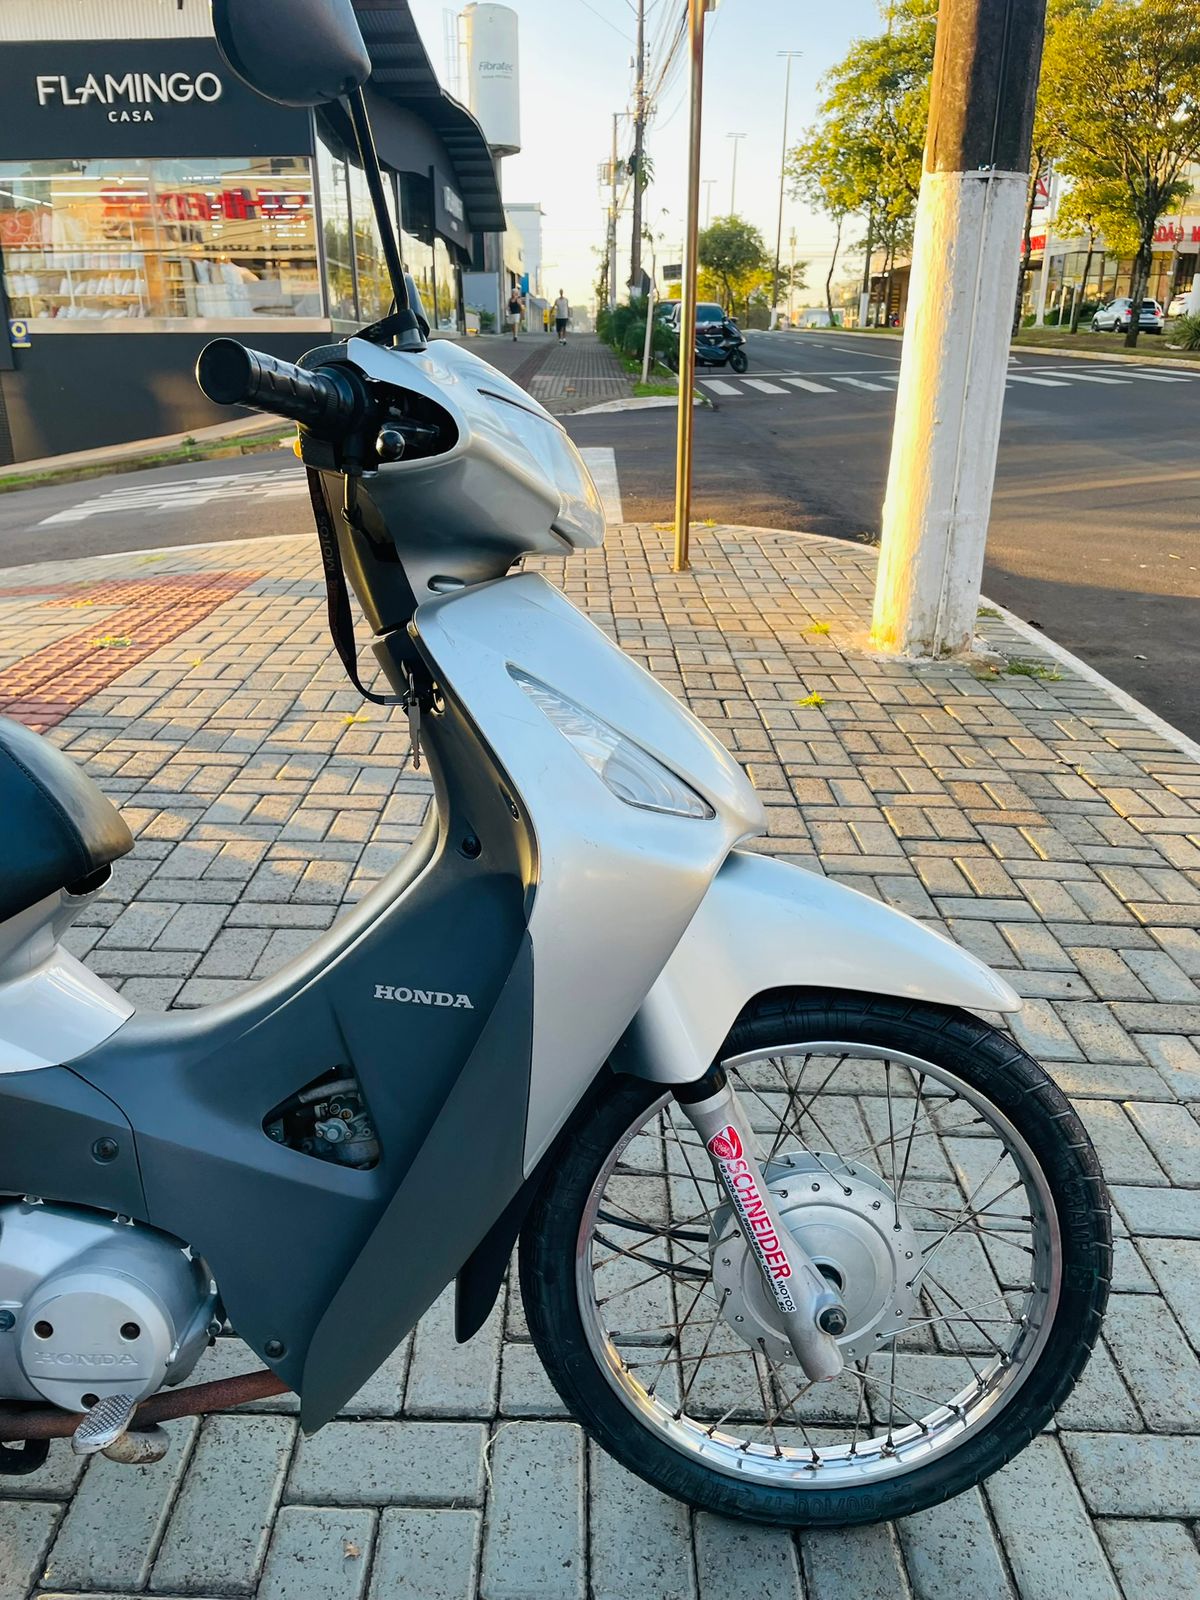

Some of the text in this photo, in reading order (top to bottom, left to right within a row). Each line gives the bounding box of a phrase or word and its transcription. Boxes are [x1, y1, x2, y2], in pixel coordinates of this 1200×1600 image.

[36, 72, 222, 105] FLAMINGO
[108, 110, 154, 122] CASA
[373, 984, 474, 1009] HONDA
[727, 1160, 795, 1312] SCHNEIDER MOTOS
[34, 1351, 139, 1367] HONDA
